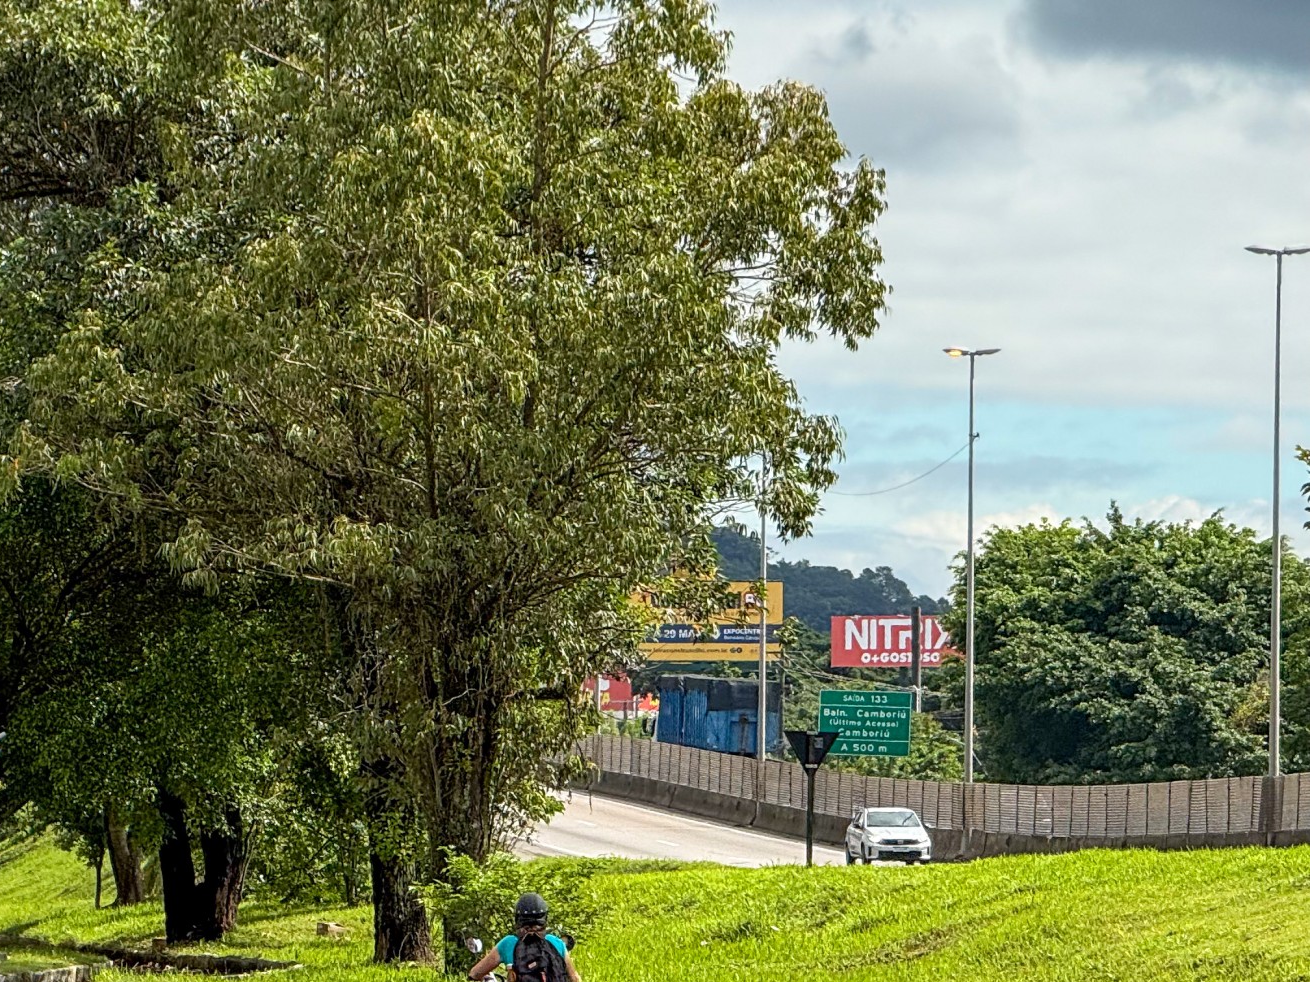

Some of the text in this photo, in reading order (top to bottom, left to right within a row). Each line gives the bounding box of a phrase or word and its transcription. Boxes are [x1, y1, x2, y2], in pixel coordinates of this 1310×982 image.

[871, 695, 888, 703] 133
[823, 708, 907, 719] Baln. Camboriú
[838, 728, 890, 738] Camboriú
[840, 743, 887, 753] A 500 m
